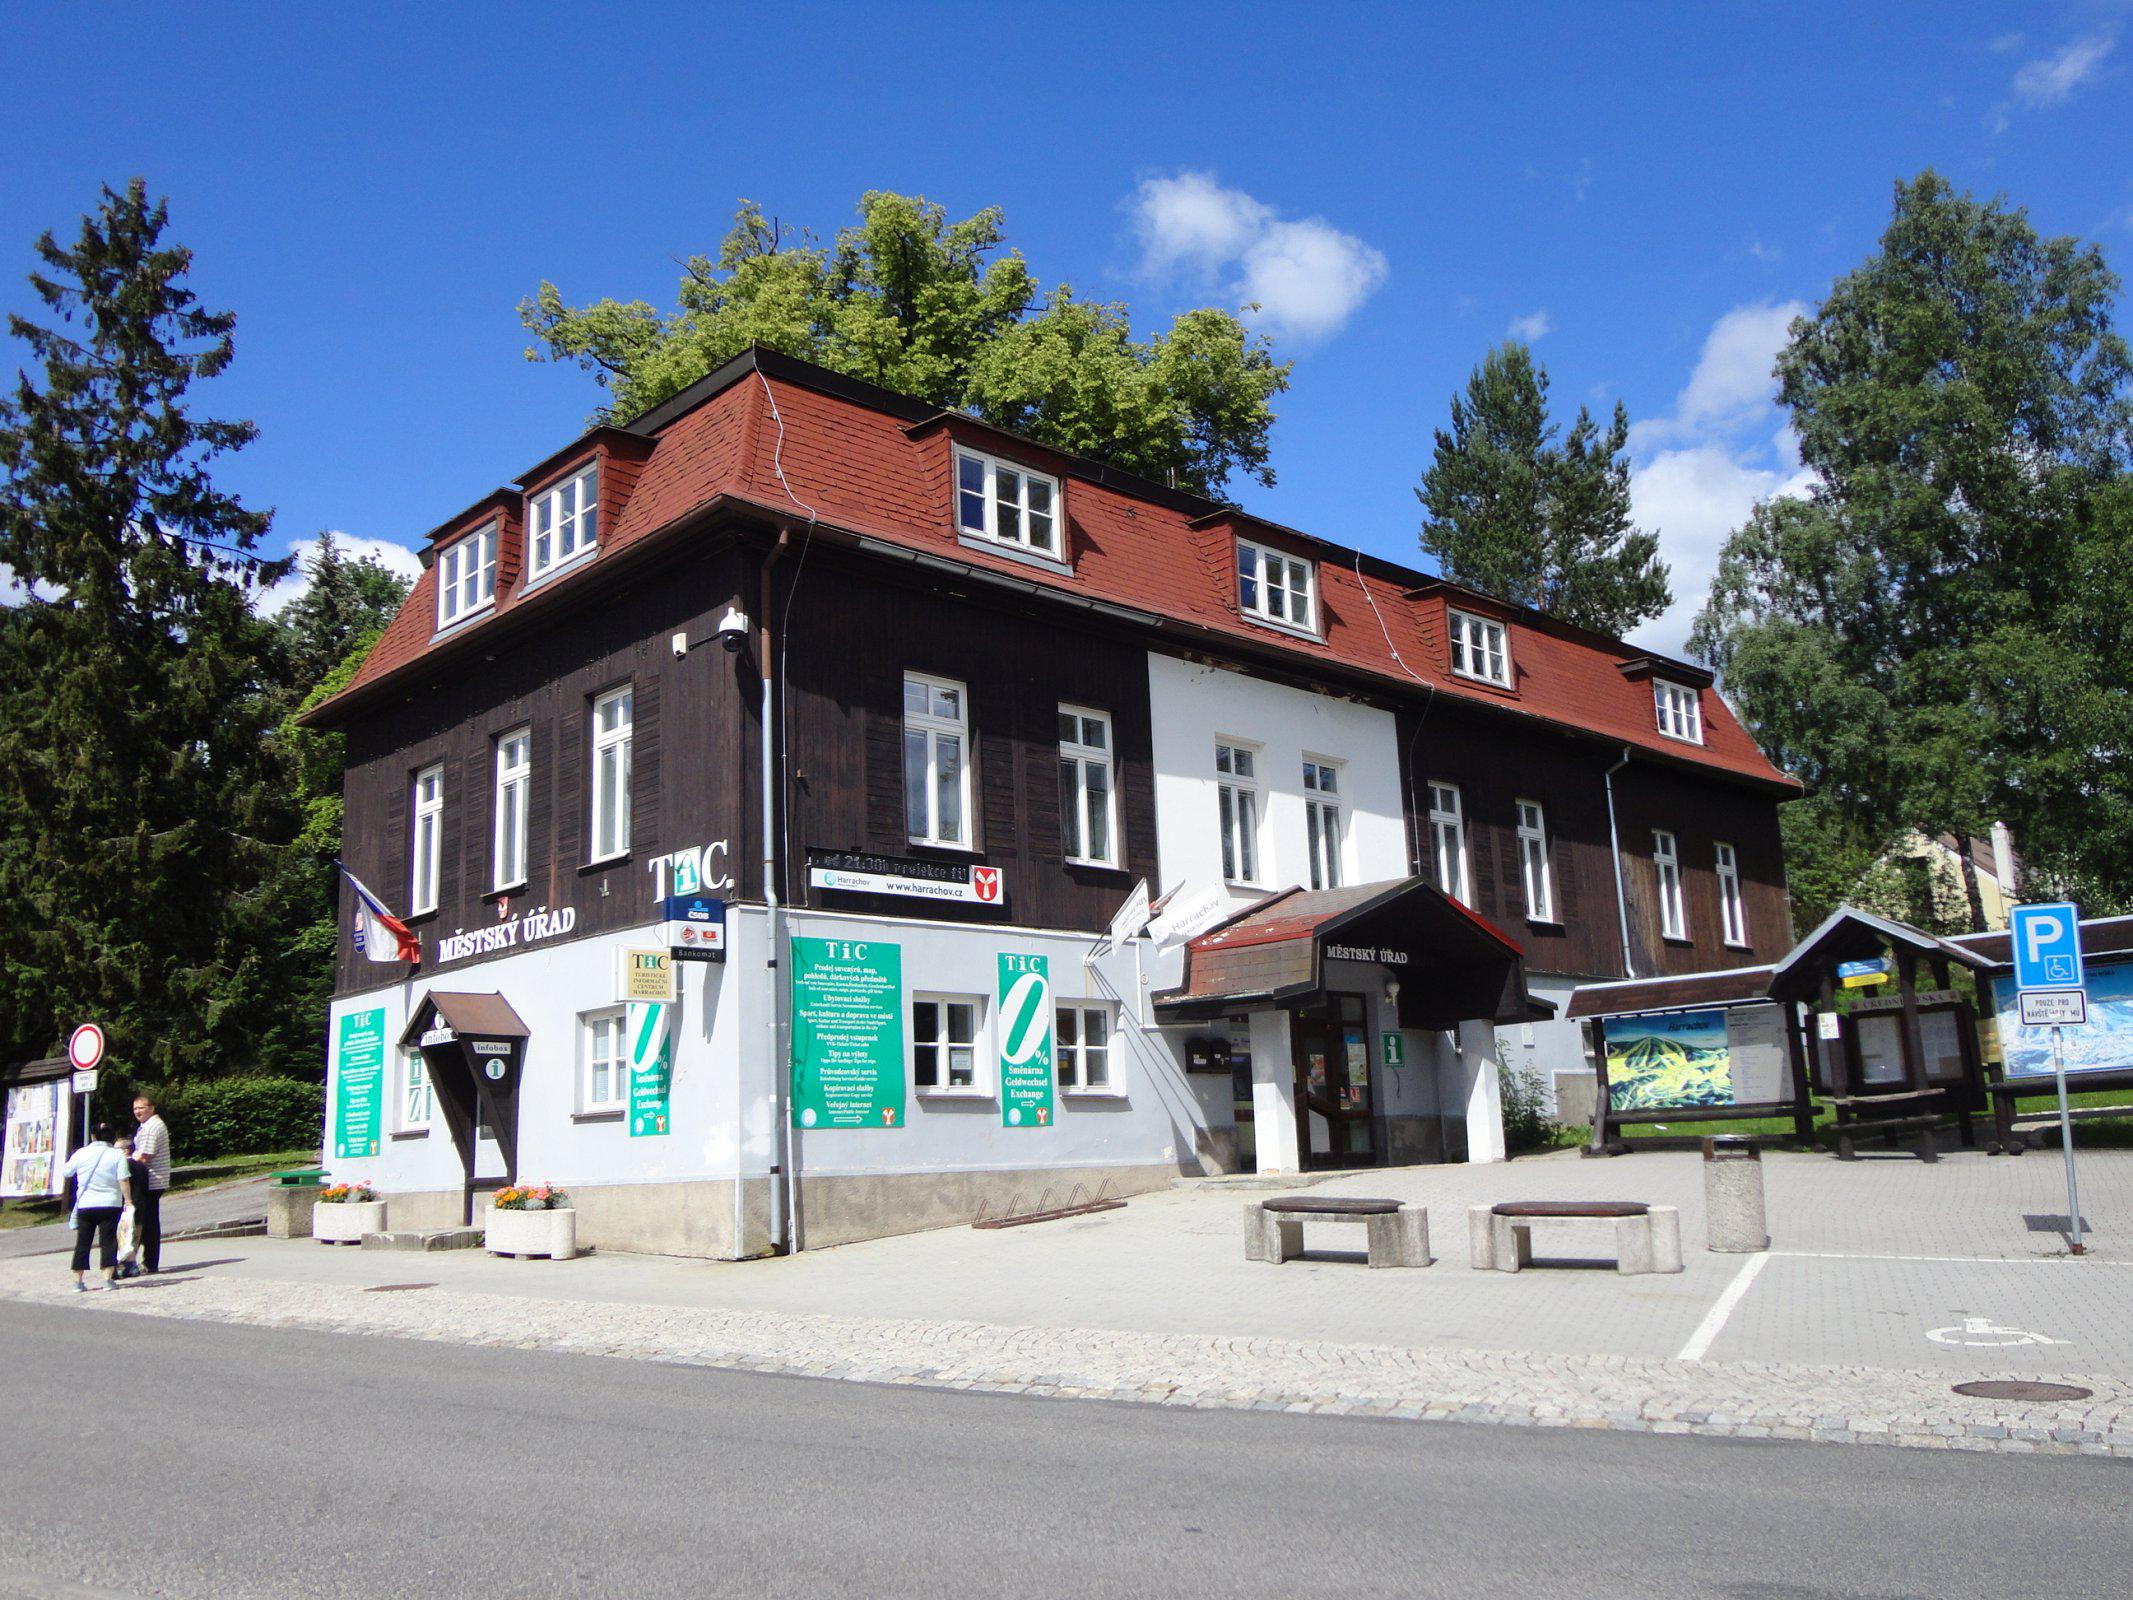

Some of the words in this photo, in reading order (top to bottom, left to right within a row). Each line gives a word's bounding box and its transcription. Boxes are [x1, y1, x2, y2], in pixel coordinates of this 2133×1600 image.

[837, 876, 870, 886] Harrachov
[887, 882, 963, 897] www.harrachov.cz
[438, 913, 519, 963] MĚSTSKÝ
[523, 905, 576, 942] ÚŘAD
[2025, 915, 2063, 963] P
[678, 949, 716, 959] Bankomat
[1326, 944, 1376, 961] MĚSTSKÝ
[1380, 948, 1408, 964] ÚŘAD
[814, 963, 834, 973] Prodej
[424, 1030, 452, 1045] infobo
[477, 1043, 509, 1052] infobox
[1009, 1066, 1043, 1075] Směnárna
[1005, 1077, 1048, 1087] Geldwechsel
[1010, 1089, 1044, 1101] Exchange
